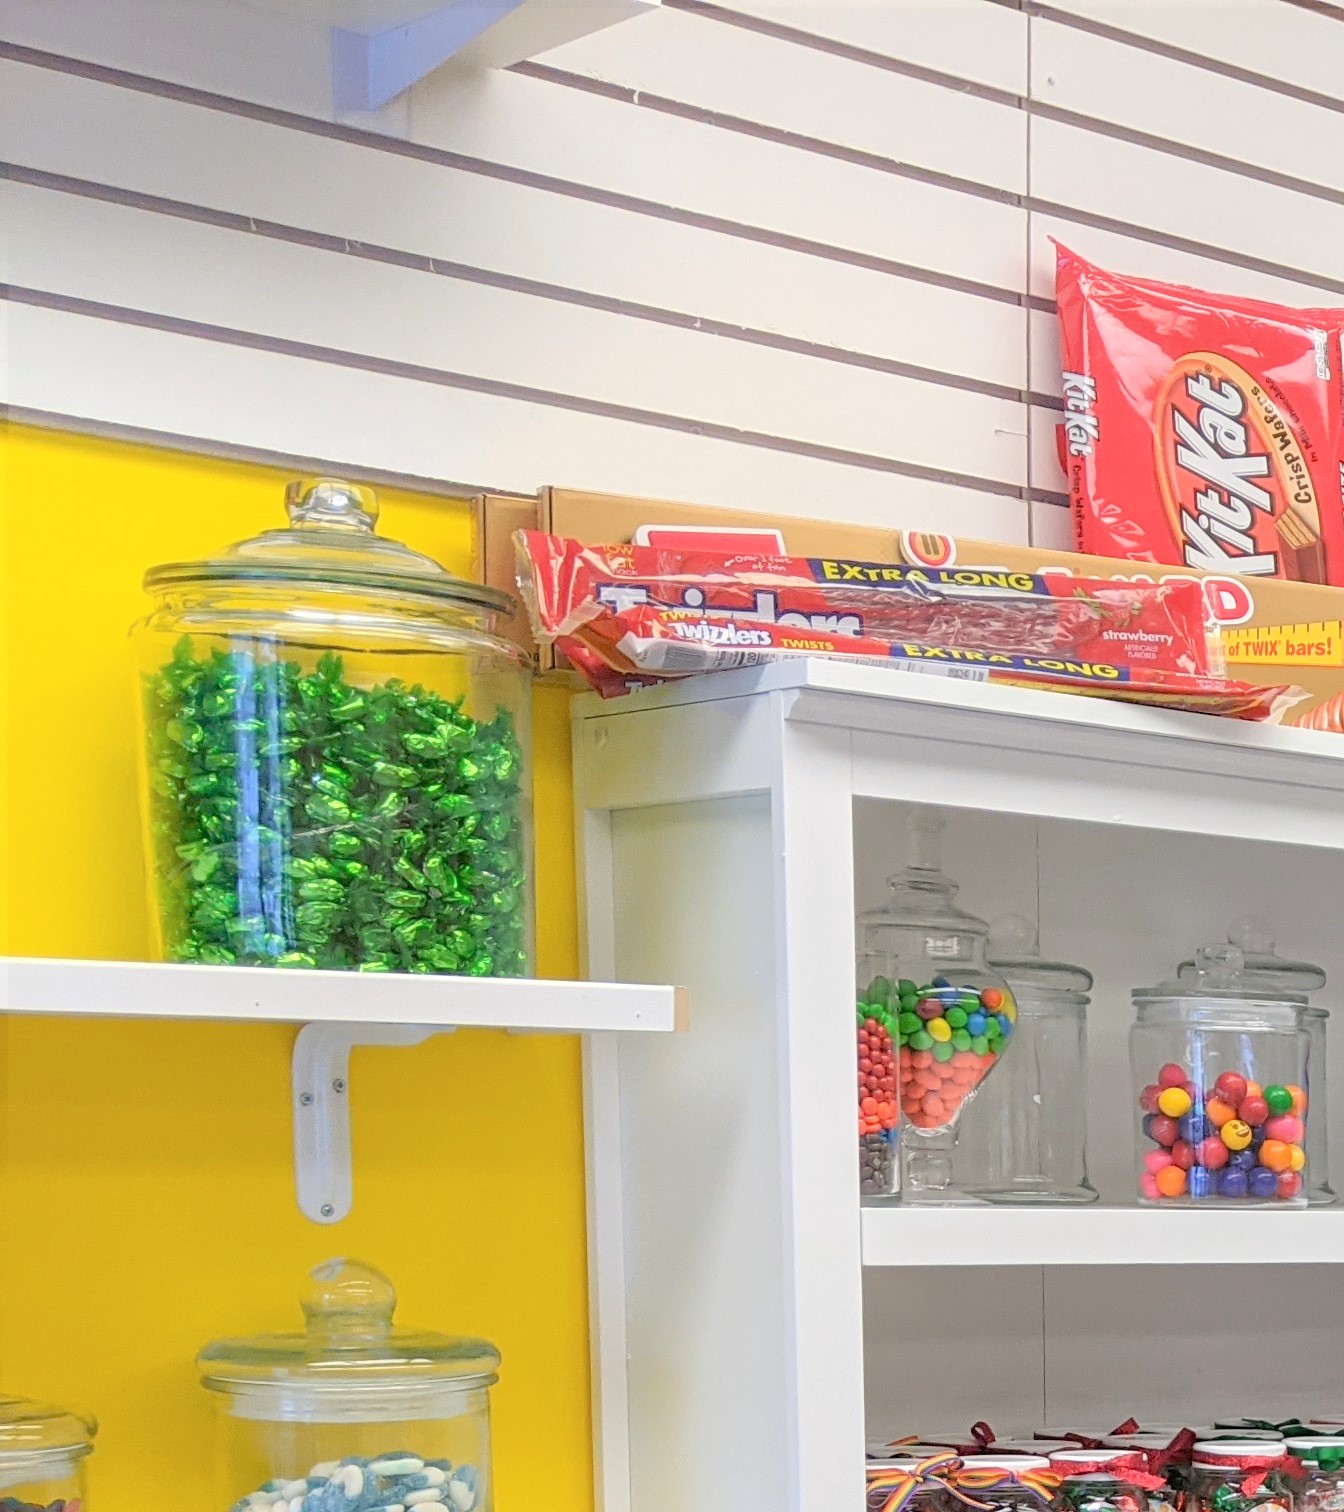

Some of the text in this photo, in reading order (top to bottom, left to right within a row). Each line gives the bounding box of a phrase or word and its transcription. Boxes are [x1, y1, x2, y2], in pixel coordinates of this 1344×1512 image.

[1250, 384, 1313, 505] Crisp Wafers
[822, 560, 1035, 591] EXTRA LONG
[668, 620, 1120, 680] Twizzlers TWISTS EXTRA LONG
[1102, 628, 1174, 647] strawberry
[1228, 637, 1333, 656] of TWIX bars!
